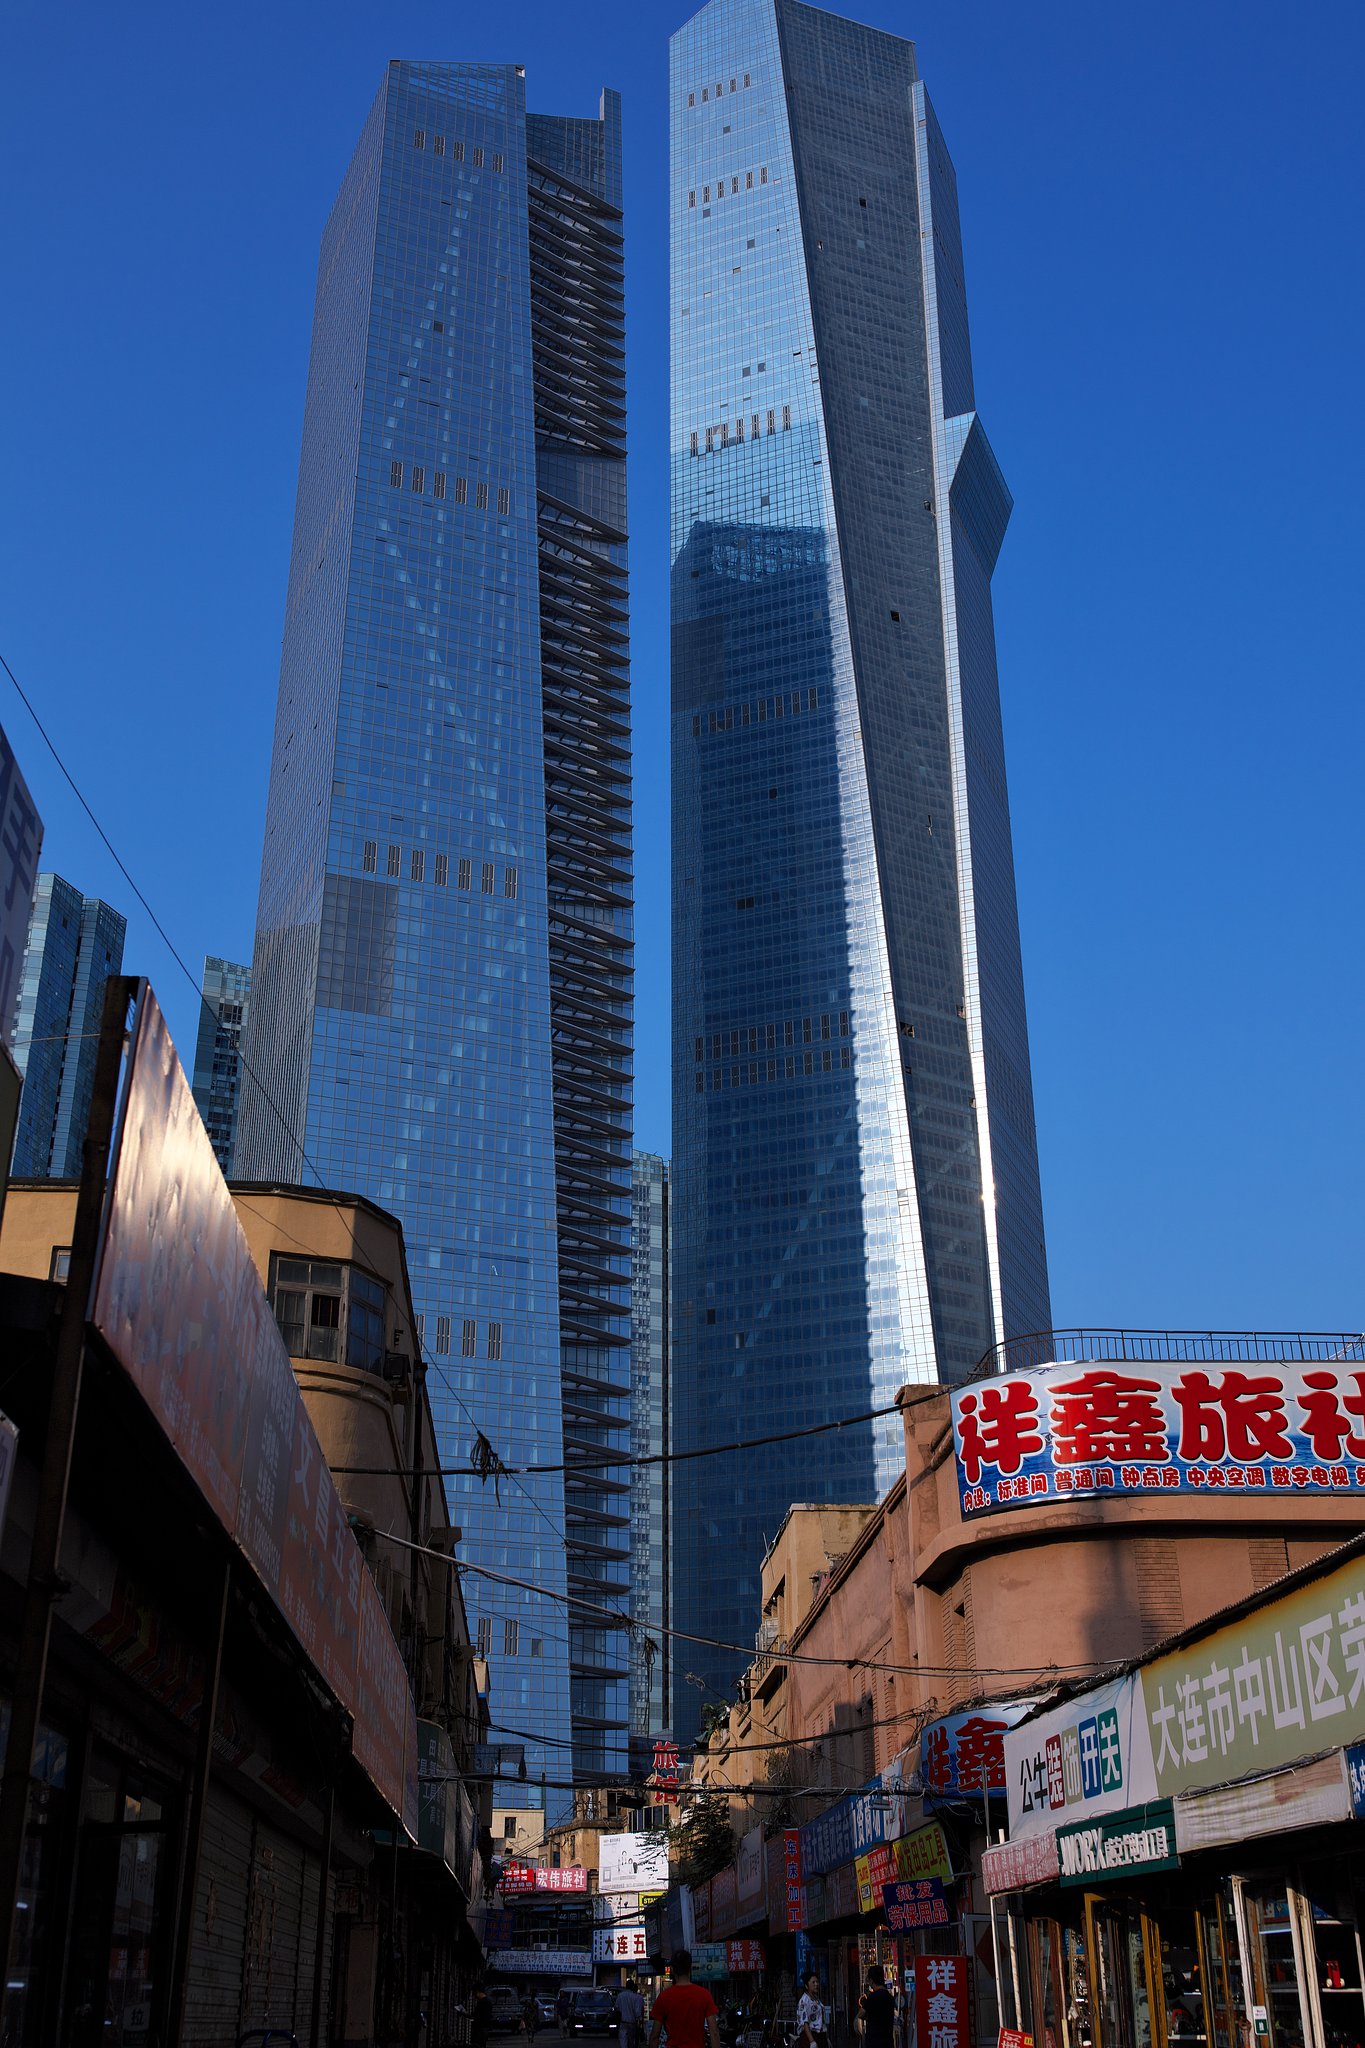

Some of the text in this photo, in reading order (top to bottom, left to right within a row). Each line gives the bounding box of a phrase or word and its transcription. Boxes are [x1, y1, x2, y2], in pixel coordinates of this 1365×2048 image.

[957, 1369, 1365, 1484] 祥鑫旅社
[998, 1472, 1048, 1502] 标准间
[1055, 1467, 1114, 1491] 普通间
[1122, 1466, 1180, 1489] 钟点房
[1187, 1466, 1265, 1488] 中央空调
[1272, 1466, 1349, 1487] 数字电视
[1019, 1715, 1121, 1814] 公牛装饰开关
[537, 1870, 585, 1889] 宏伟旅社
[786, 1840, 801, 1924] 车床加工
[896, 1881, 935, 1902] 批发
[888, 1899, 949, 1930] 劳保用品
[926, 1959, 959, 2048] 祥鑫旅
